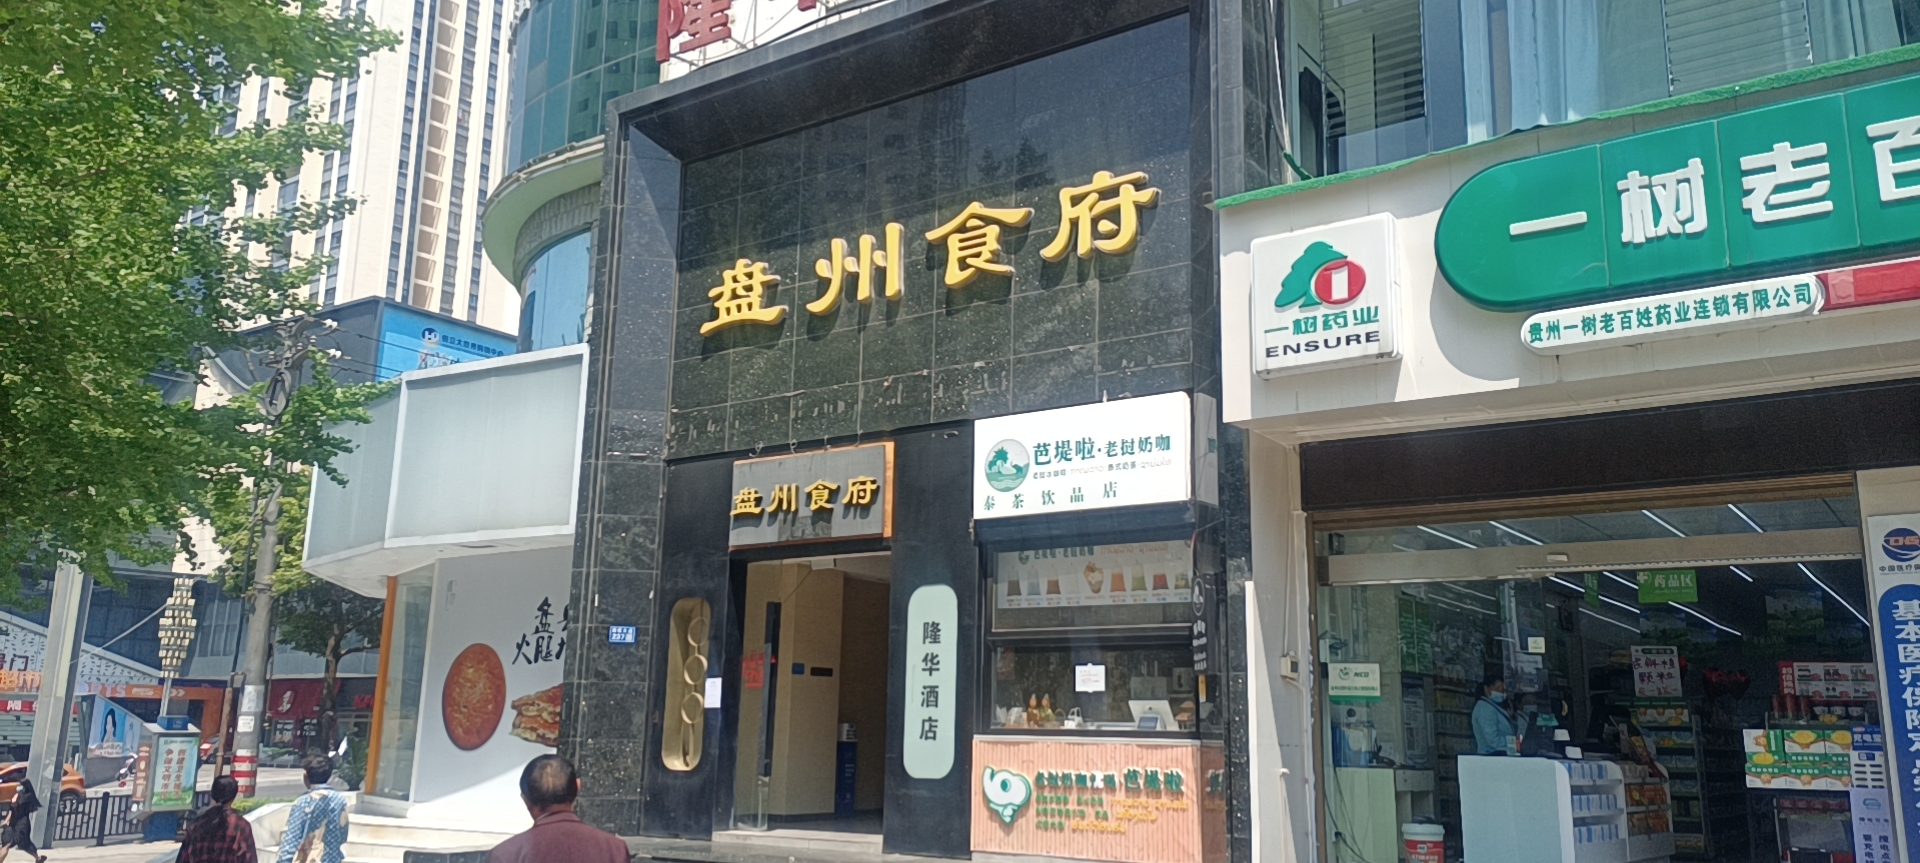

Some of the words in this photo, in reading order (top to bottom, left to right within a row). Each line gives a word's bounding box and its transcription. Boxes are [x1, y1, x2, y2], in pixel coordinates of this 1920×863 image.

[700, 171, 1160, 337] 盘州食府
[1264, 305, 1380, 335] 一树药业
[1527, 282, 1813, 344] 贵州一树老百姓药业连锁有限公司
[1265, 330, 1380, 358] ENSURE
[730, 476, 878, 517] 盘州食府
[919, 621, 942, 741] 隆华酒店
